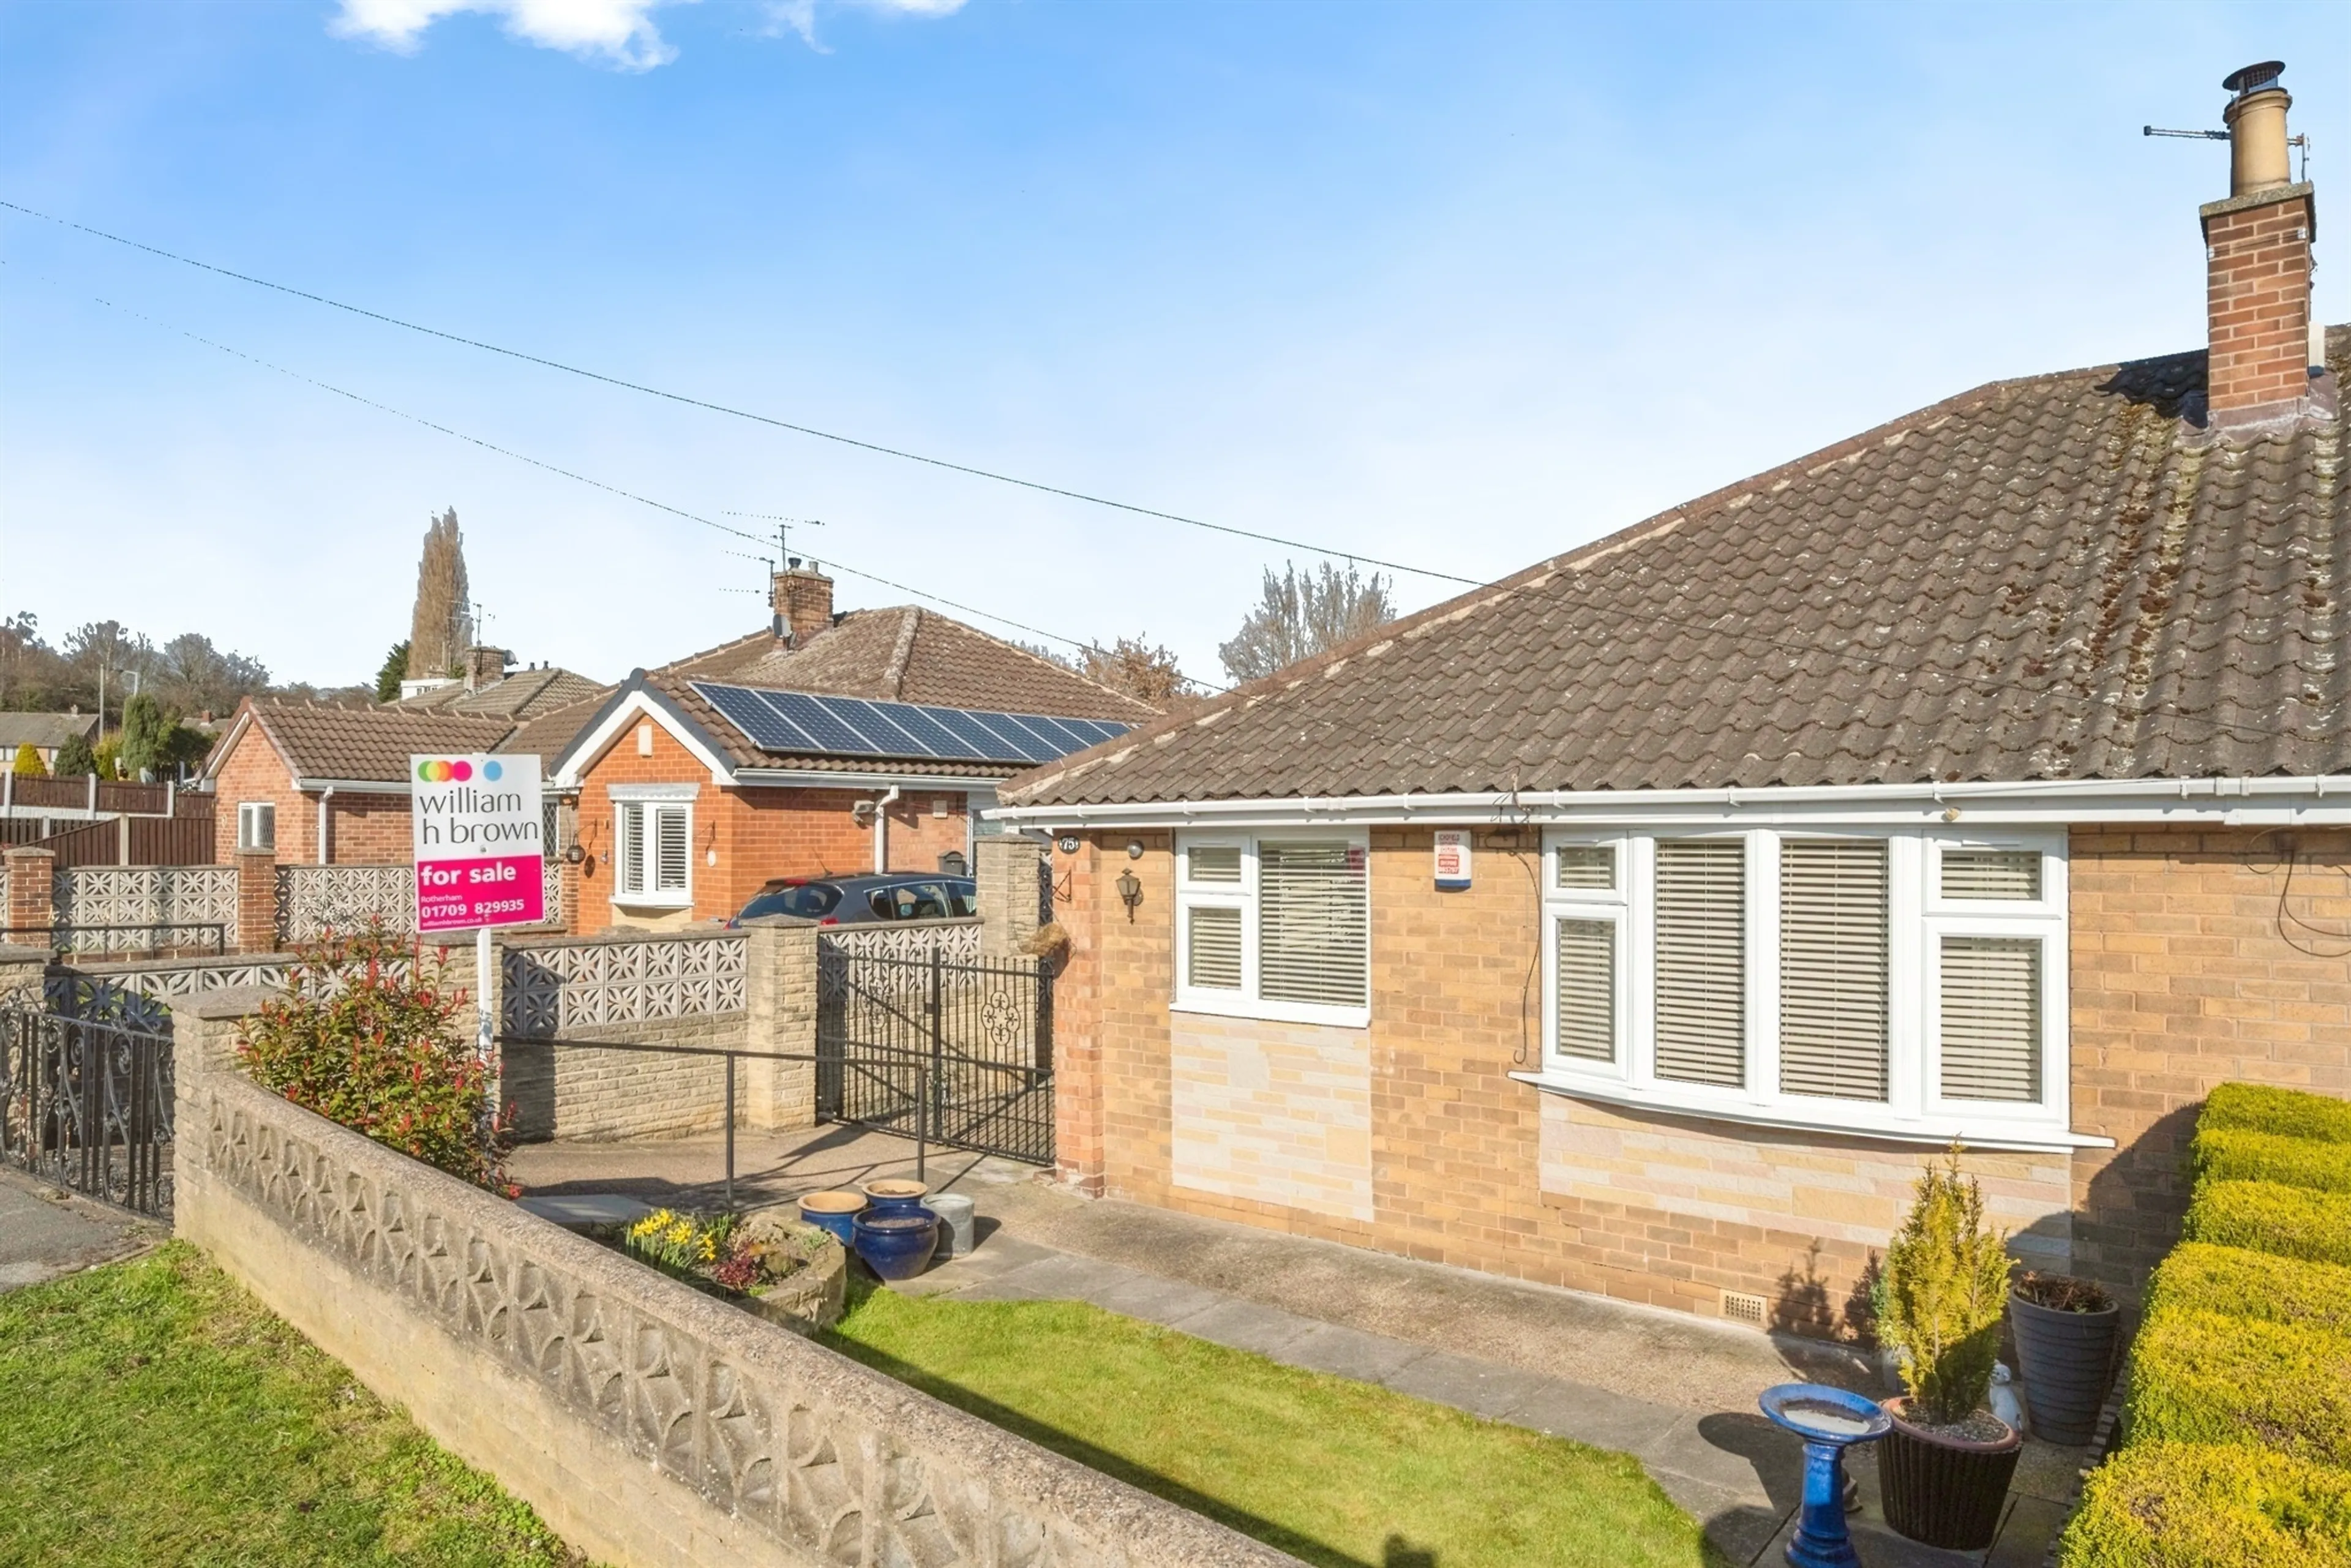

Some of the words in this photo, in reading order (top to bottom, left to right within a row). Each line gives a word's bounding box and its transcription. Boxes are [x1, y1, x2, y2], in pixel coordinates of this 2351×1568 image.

[419, 787, 521, 814] william
[423, 818, 440, 844] h
[451, 817, 538, 844] brown
[1062, 837, 1075, 850] 75
[421, 865, 462, 886] for
[469, 861, 517, 883] sale
[421, 895, 463, 903] Rotherham
[421, 904, 467, 918] 01709
[474, 899, 525, 914] 829935
[422, 917, 482, 927] williamhbrown.co.uk
